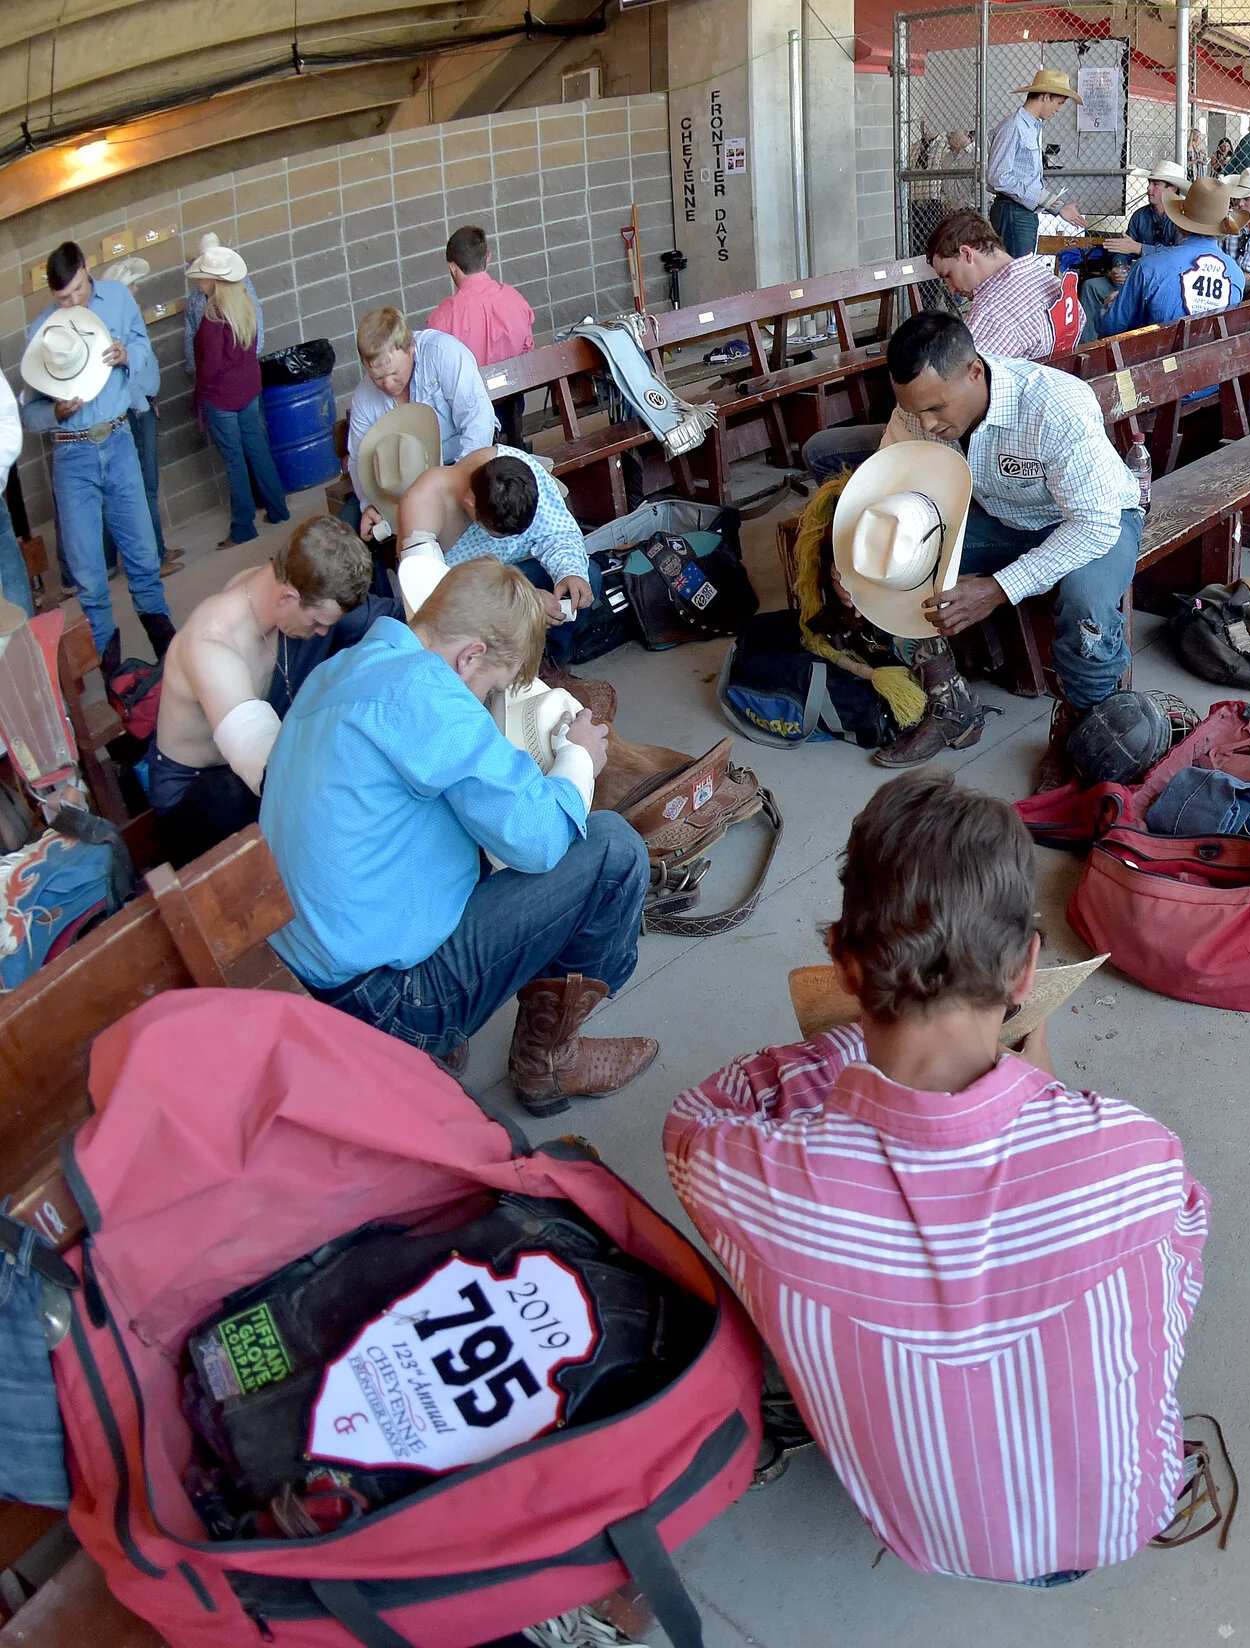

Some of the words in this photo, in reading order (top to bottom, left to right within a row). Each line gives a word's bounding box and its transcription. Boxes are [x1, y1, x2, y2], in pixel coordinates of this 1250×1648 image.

[681, 117, 696, 222] CHEYENNE
[710, 90, 726, 197] FRONTIER
[715, 208, 729, 262] DAYS
[1065, 296, 1074, 326] 2
[1192, 275, 1223, 300] 418
[1021, 461, 1040, 470] HOPE
[505, 1281, 571, 1350] 2019
[239, 1324, 272, 1385] GLOVE
[413, 1279, 543, 1428] 795
[349, 1356, 384, 1420] FRONTIER
[378, 1418, 408, 1460] DAYS
[366, 1345, 428, 1455] CHEYENNE
[408, 1372, 458, 1435] Annual
